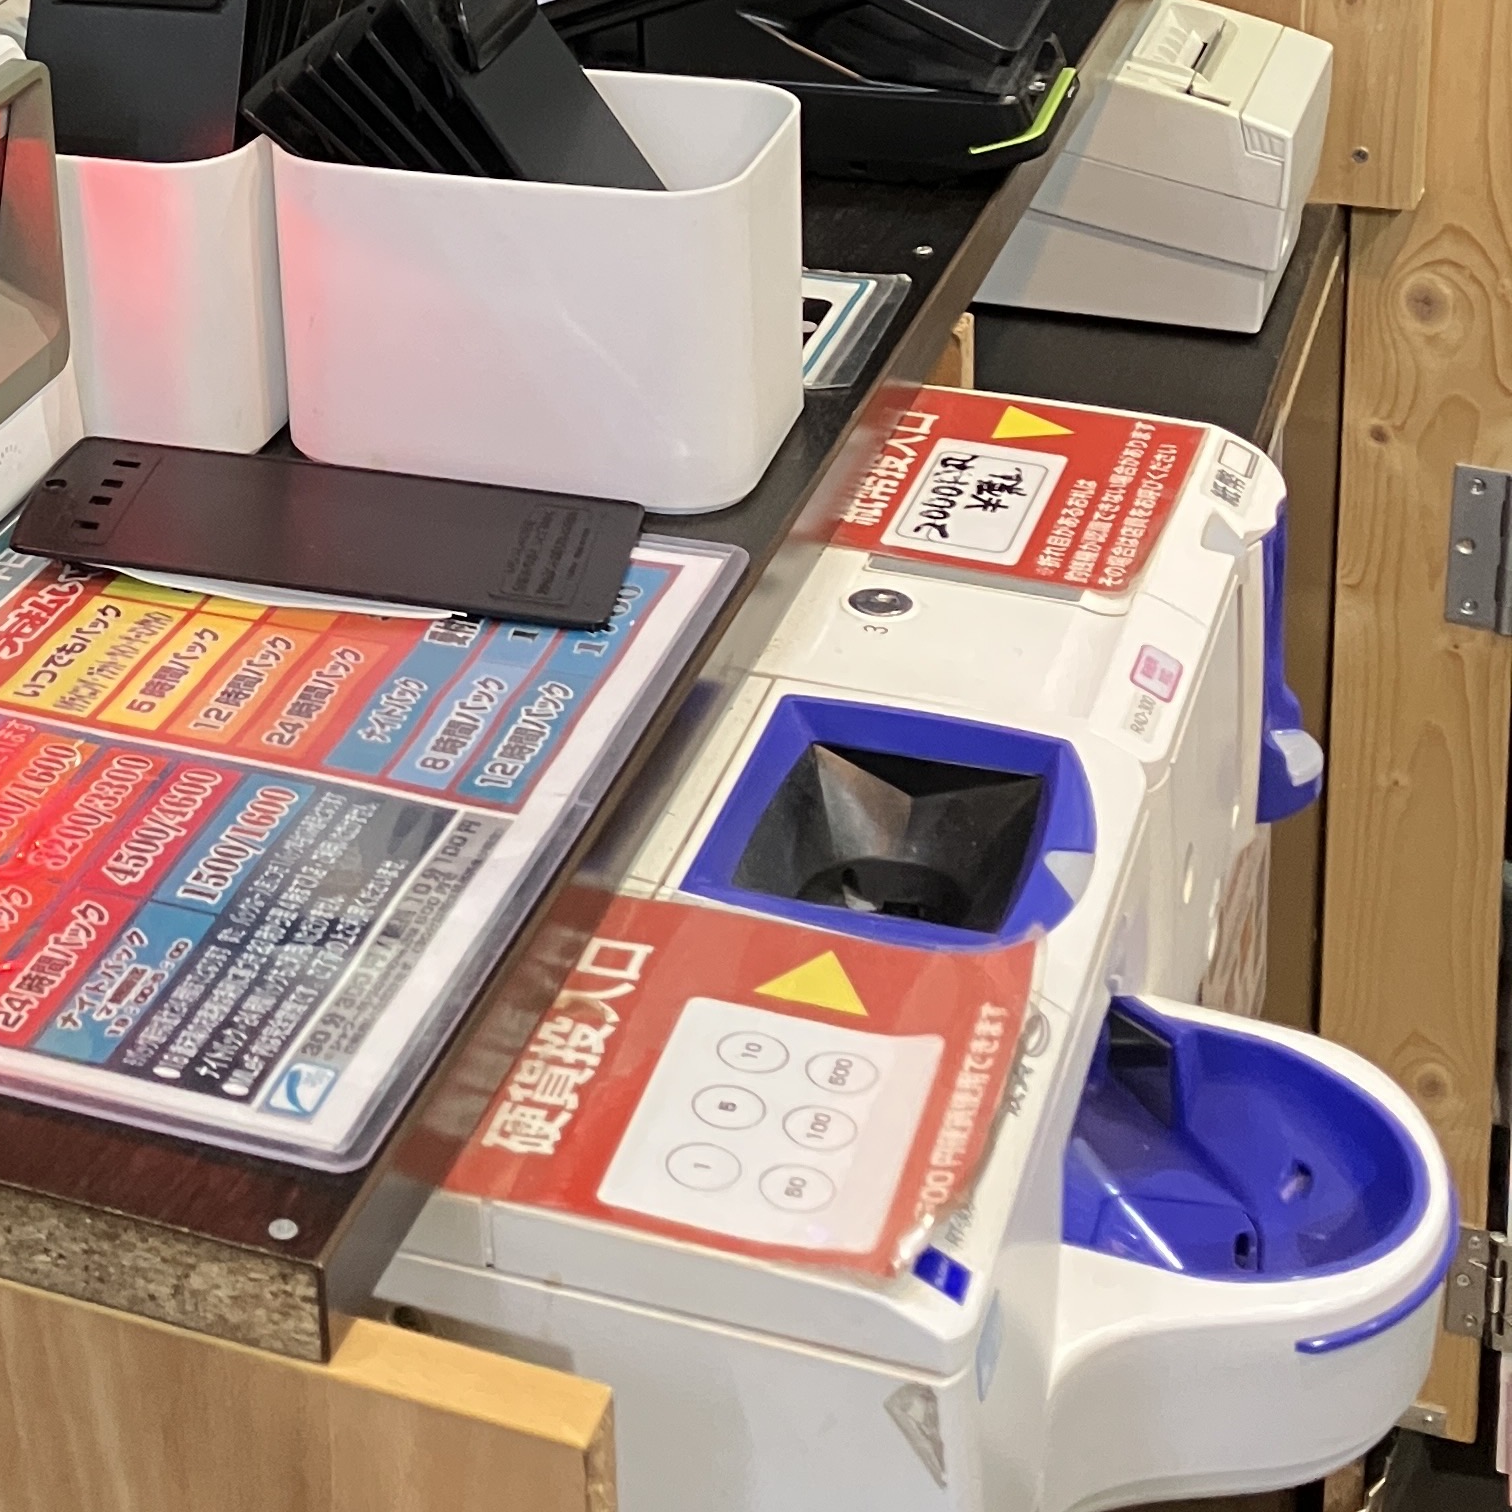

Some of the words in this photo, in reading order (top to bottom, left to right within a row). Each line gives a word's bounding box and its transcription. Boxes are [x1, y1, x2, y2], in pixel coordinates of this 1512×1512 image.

[843, 410, 941, 527] 紙幣投入口
[11, 601, 129, 701] いつでもパック
[122, 625, 225, 715] 5時間パック
[189, 634, 299, 735] 12時間パック
[256, 644, 368, 748] 24時間パック
[350, 674, 434, 745] ナイトパック
[410, 674, 510, 772] 8時間パック
[469, 678, 579, 792] 12時間パック
[94, 764, 232, 889] 4500/4600
[50, 925, 154, 1032] ナイトパック
[173, 782, 308, 907] 1500/1600
[481, 936, 654, 1156] 硬貨投入口
[742, 1041, 763, 1059] 10
[827, 1057, 854, 1088] 500
[807, 1112, 831, 1138] 100
[785, 1176, 807, 1198] 50
